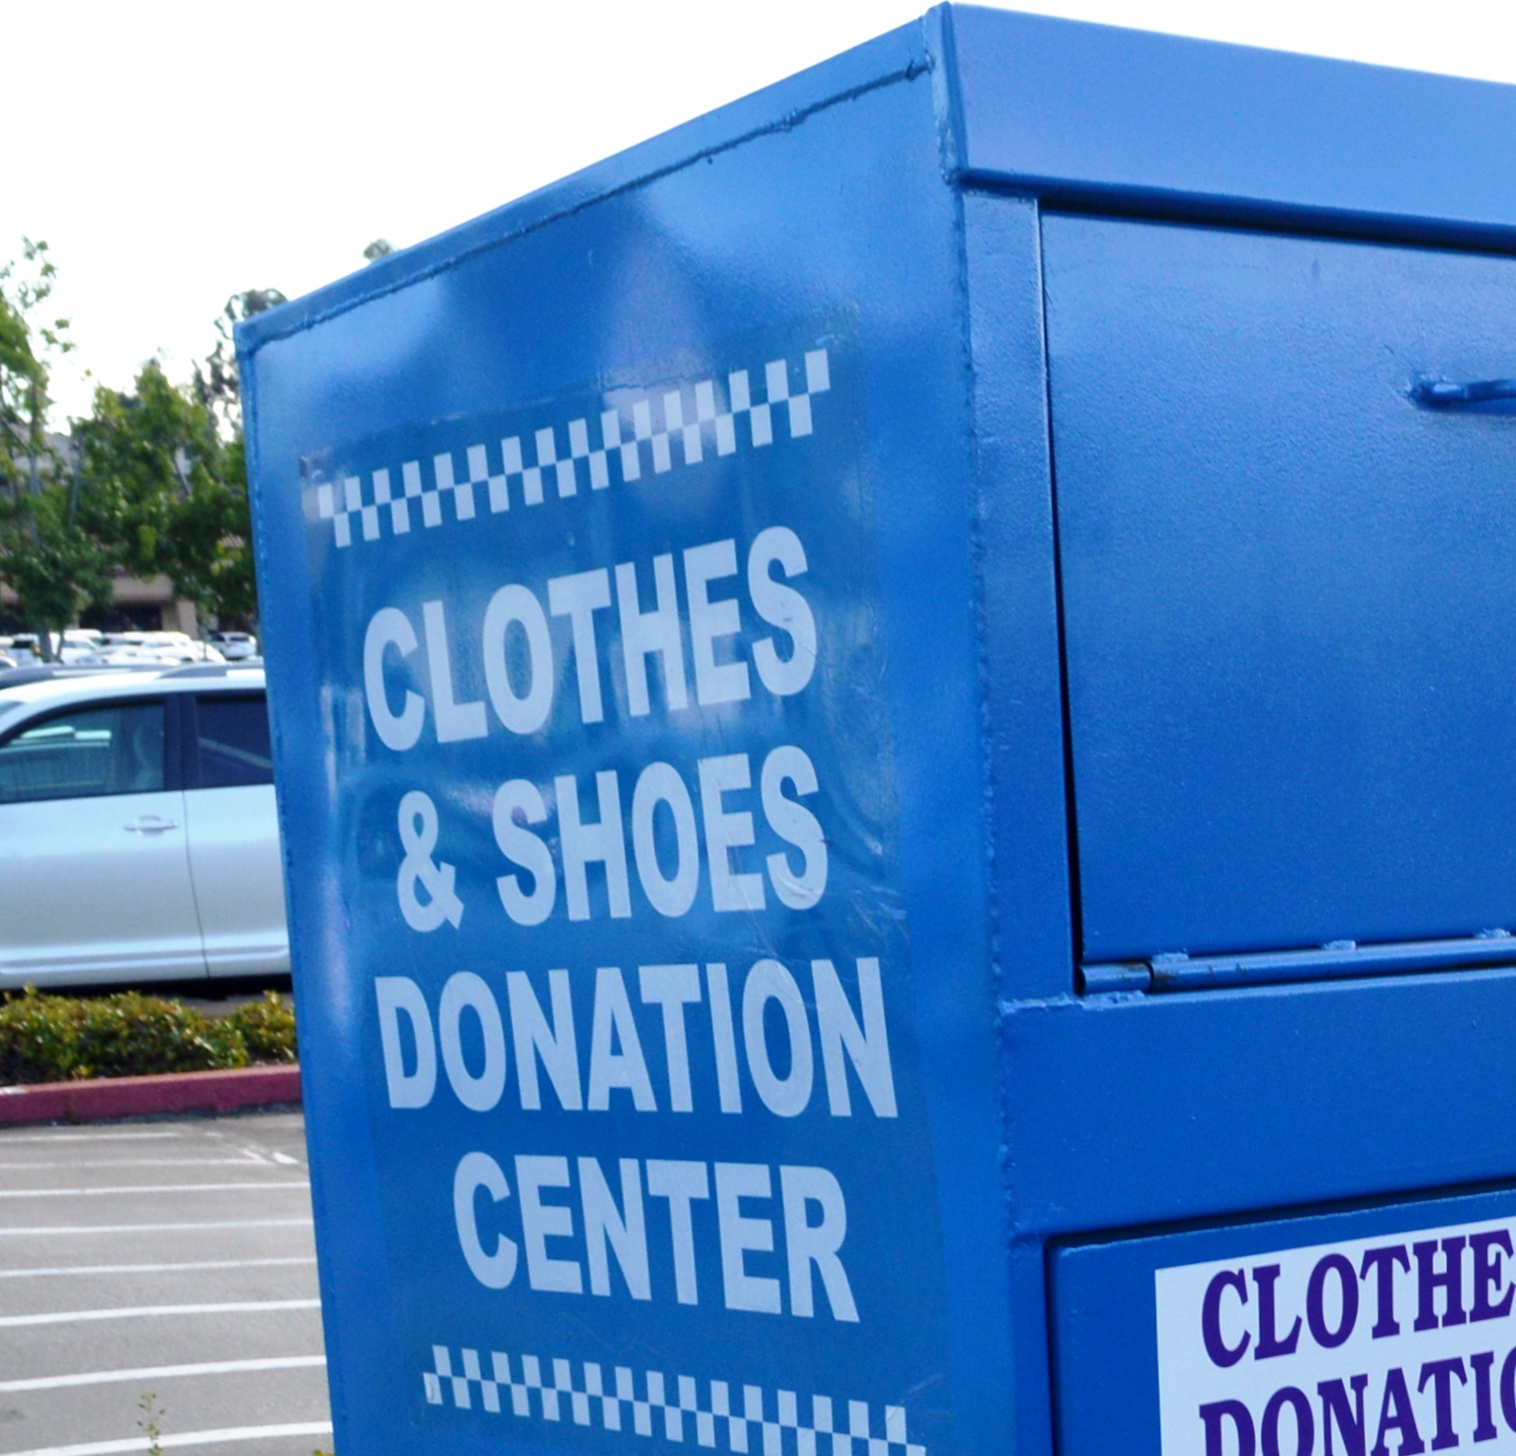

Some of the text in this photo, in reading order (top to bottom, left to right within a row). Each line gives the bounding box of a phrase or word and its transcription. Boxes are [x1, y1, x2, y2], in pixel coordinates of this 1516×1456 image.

[363, 527, 816, 752] CLOTHES
[399, 747, 827, 930] & SHOES
[376, 959, 896, 1116] DONATION
[455, 1153, 858, 1321] CENTER
